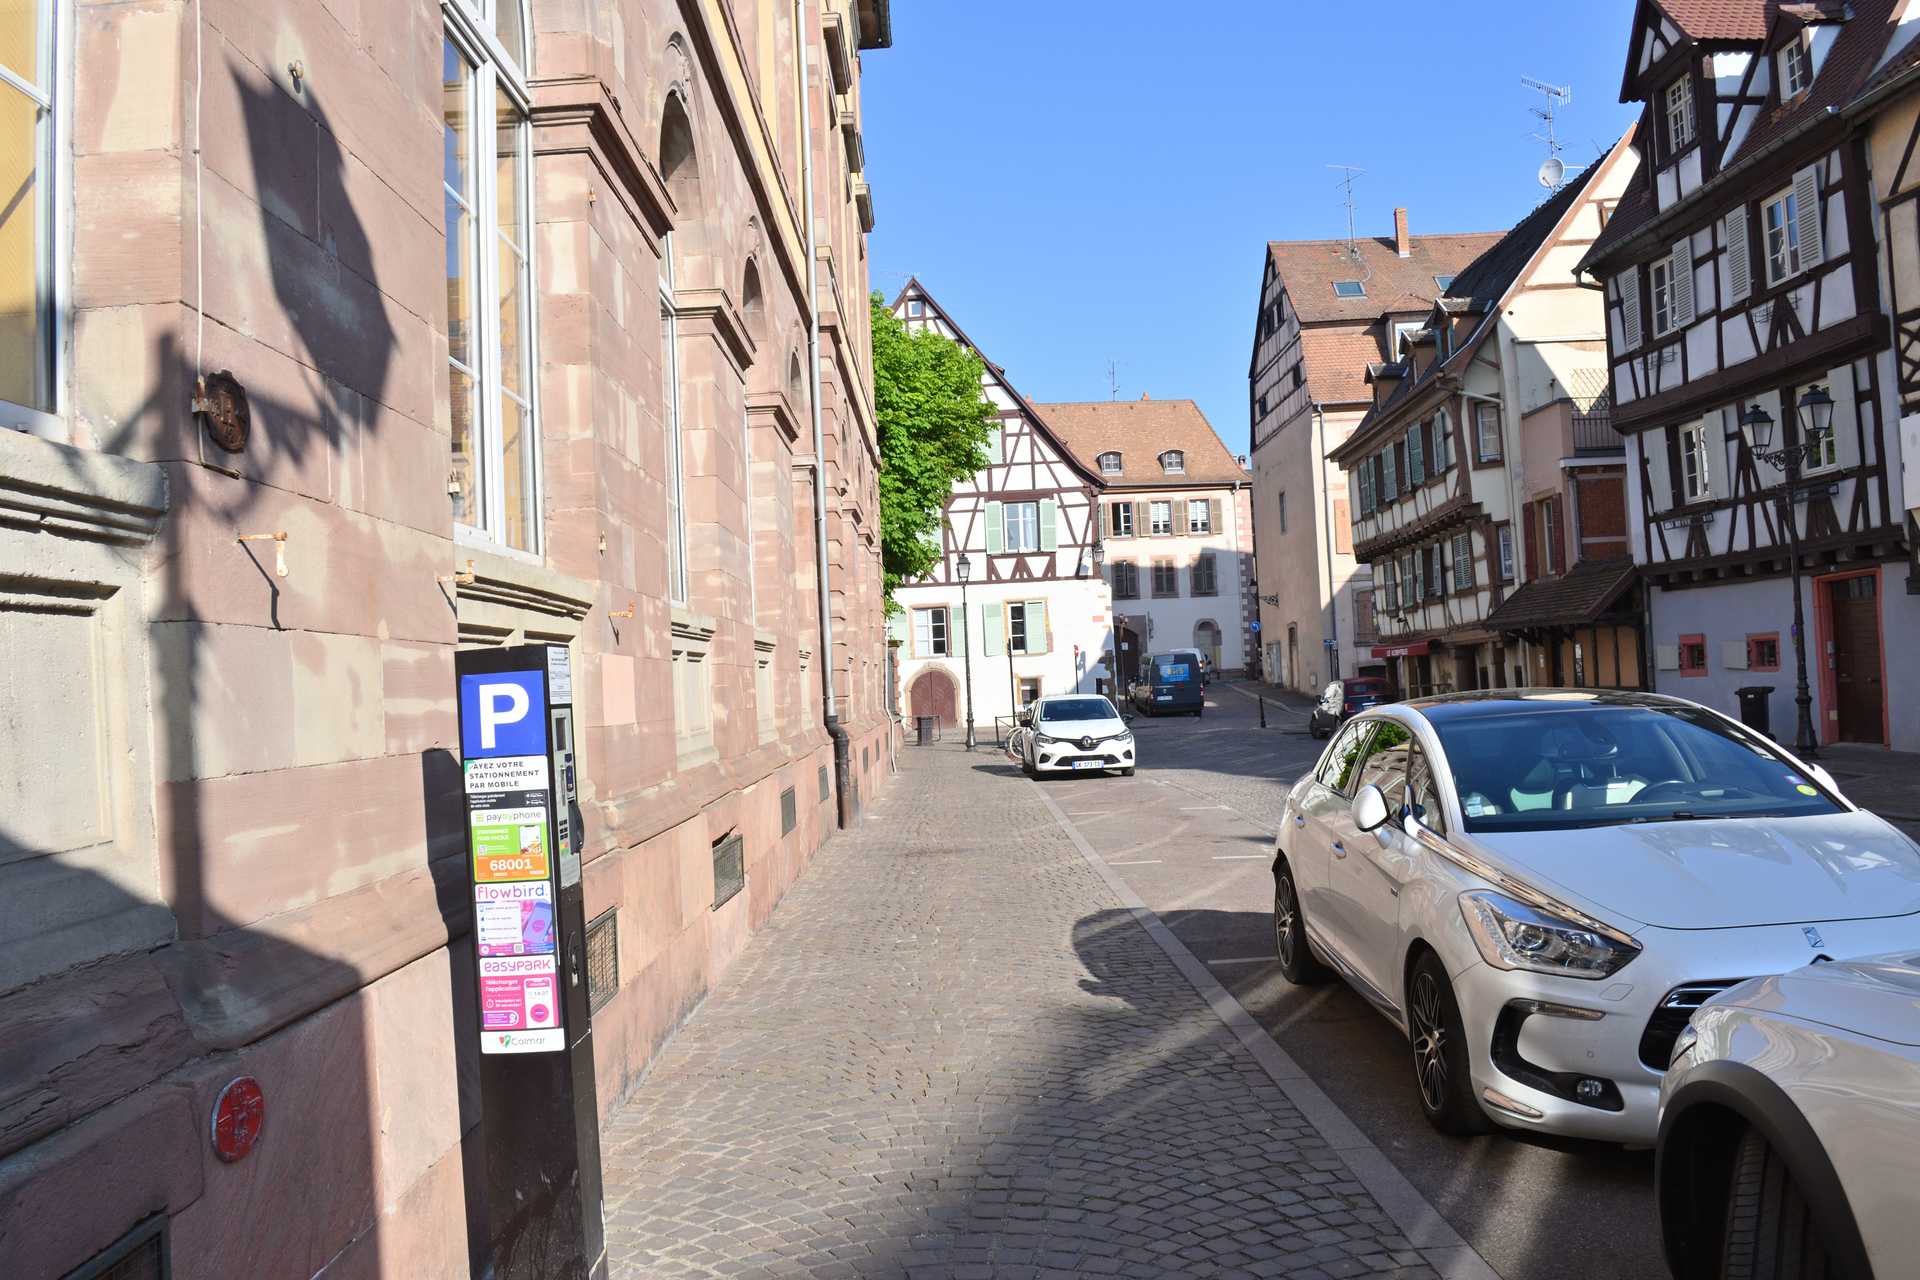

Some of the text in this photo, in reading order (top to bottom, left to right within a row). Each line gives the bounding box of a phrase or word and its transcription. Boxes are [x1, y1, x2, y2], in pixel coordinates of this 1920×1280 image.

[479, 683, 530, 749] P
[496, 761, 524, 769] VOTRE
[469, 769, 539, 780] STATIONNEMENT
[487, 780, 519, 788] MOBILE
[486, 811, 541, 823] paybyphone
[489, 858, 533, 871] 68001
[511, 1036, 546, 1046] Colmar
